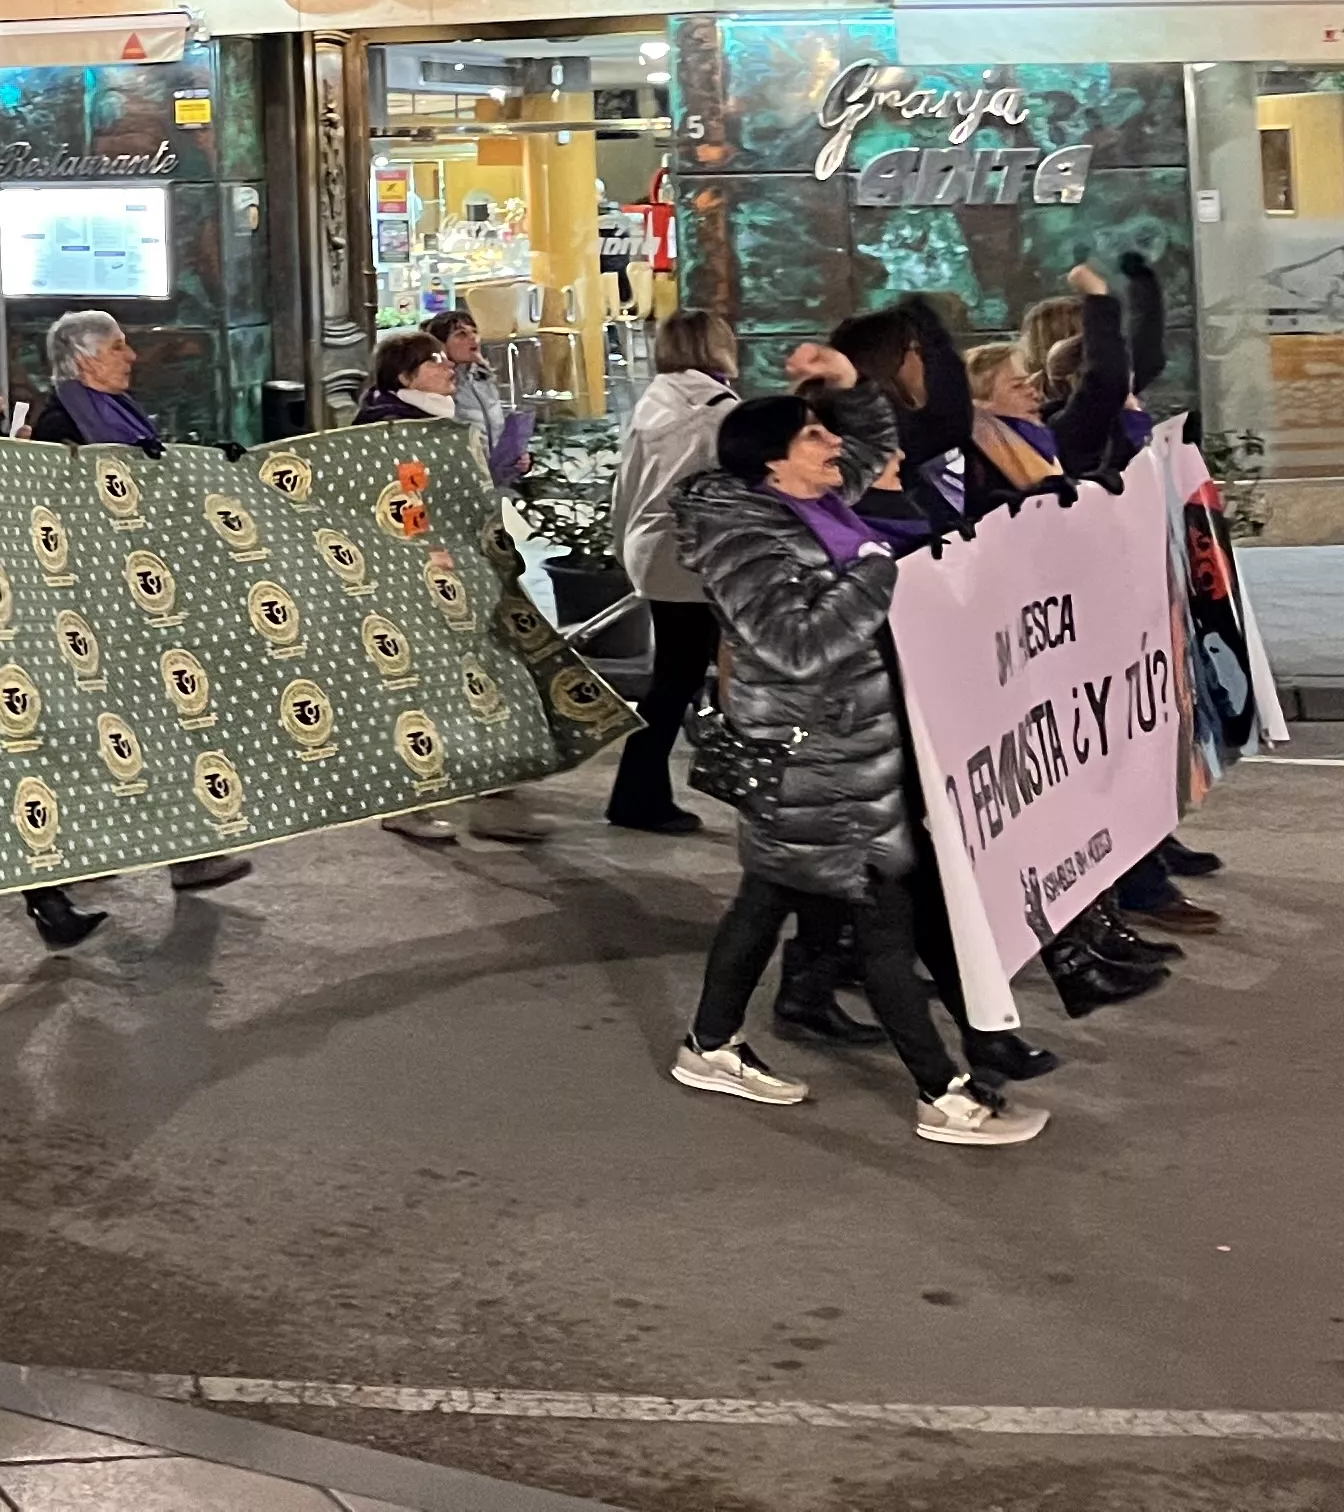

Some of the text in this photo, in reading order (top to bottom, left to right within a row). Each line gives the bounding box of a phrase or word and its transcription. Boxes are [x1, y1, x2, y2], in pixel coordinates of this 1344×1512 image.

[686, 114, 706, 139] 5
[1072, 675, 1112, 765] ¿Y
[1124, 631, 1169, 740] TÚ?
